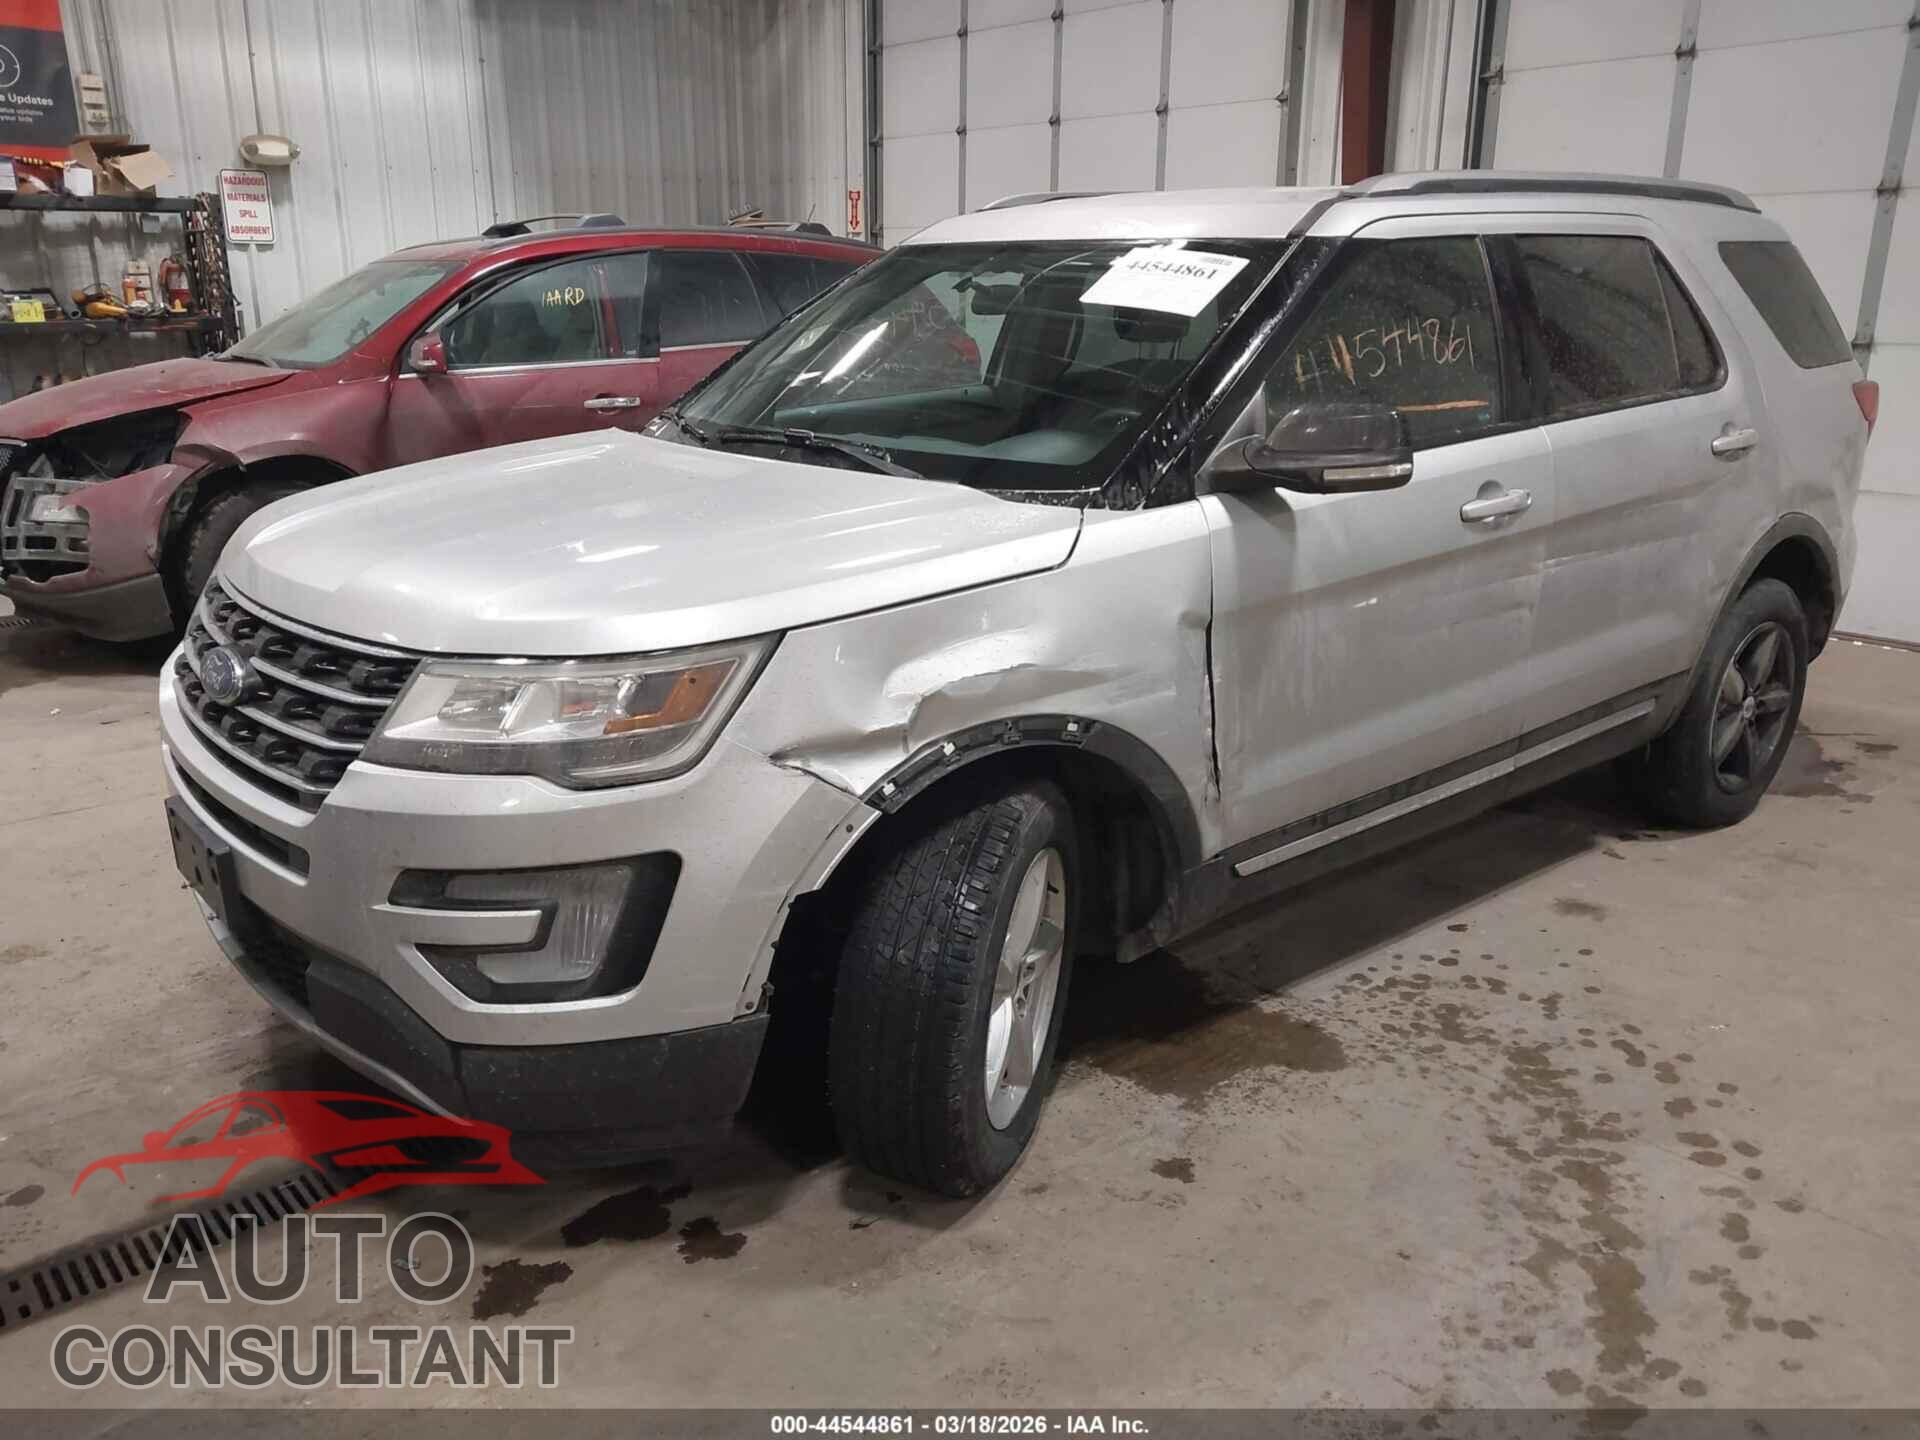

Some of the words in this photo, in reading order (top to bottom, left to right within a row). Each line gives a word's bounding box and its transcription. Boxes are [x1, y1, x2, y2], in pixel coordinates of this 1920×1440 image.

[8, 92, 54, 106] Updates
[224, 176, 265, 186] HAZARDOUS
[227, 192, 266, 202] MATERIALS
[239, 209, 258, 219] SPILL
[230, 226, 271, 235] ABSORBENT
[1127, 260, 1218, 280] 44544861
